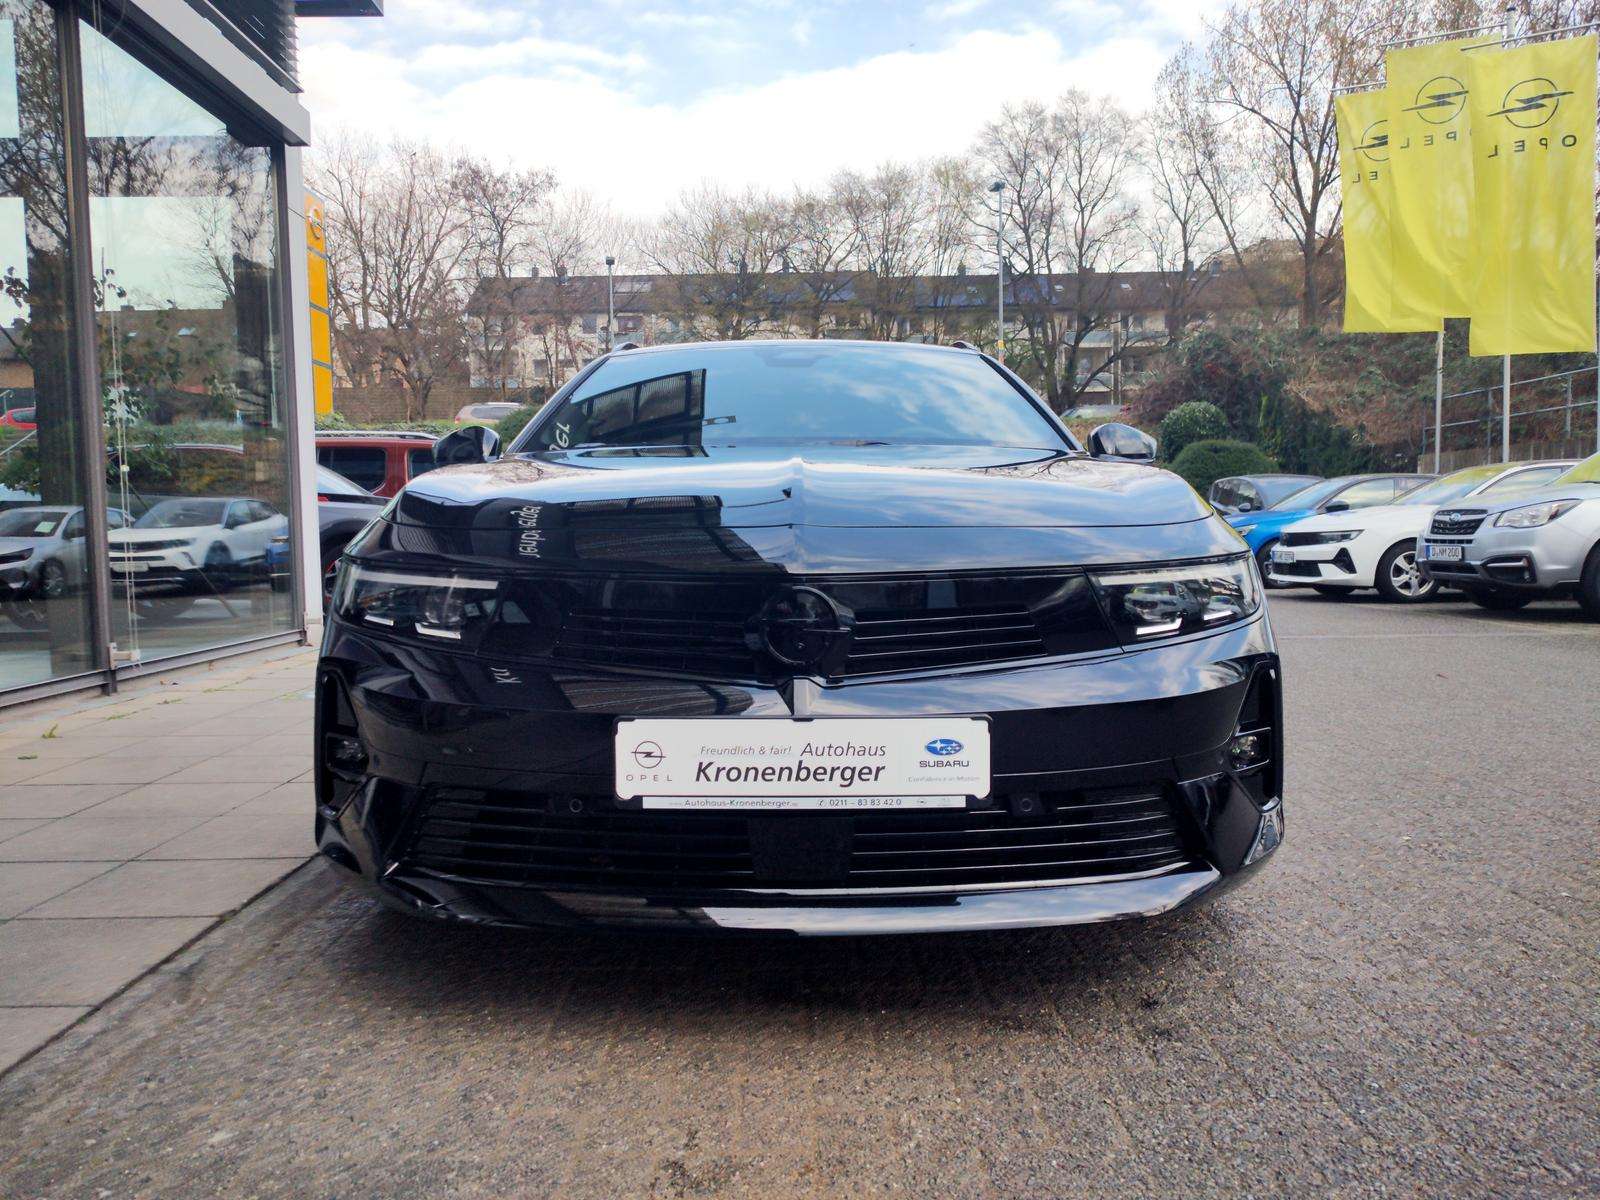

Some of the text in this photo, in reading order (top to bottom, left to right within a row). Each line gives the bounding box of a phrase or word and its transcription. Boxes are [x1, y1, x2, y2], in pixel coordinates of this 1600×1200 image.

[700, 741, 886, 757] Freundlich & fair! Autohaus
[919, 760, 970, 768] SUBARU
[625, 774, 673, 782] OPEL
[695, 760, 886, 788] Kronenberger
